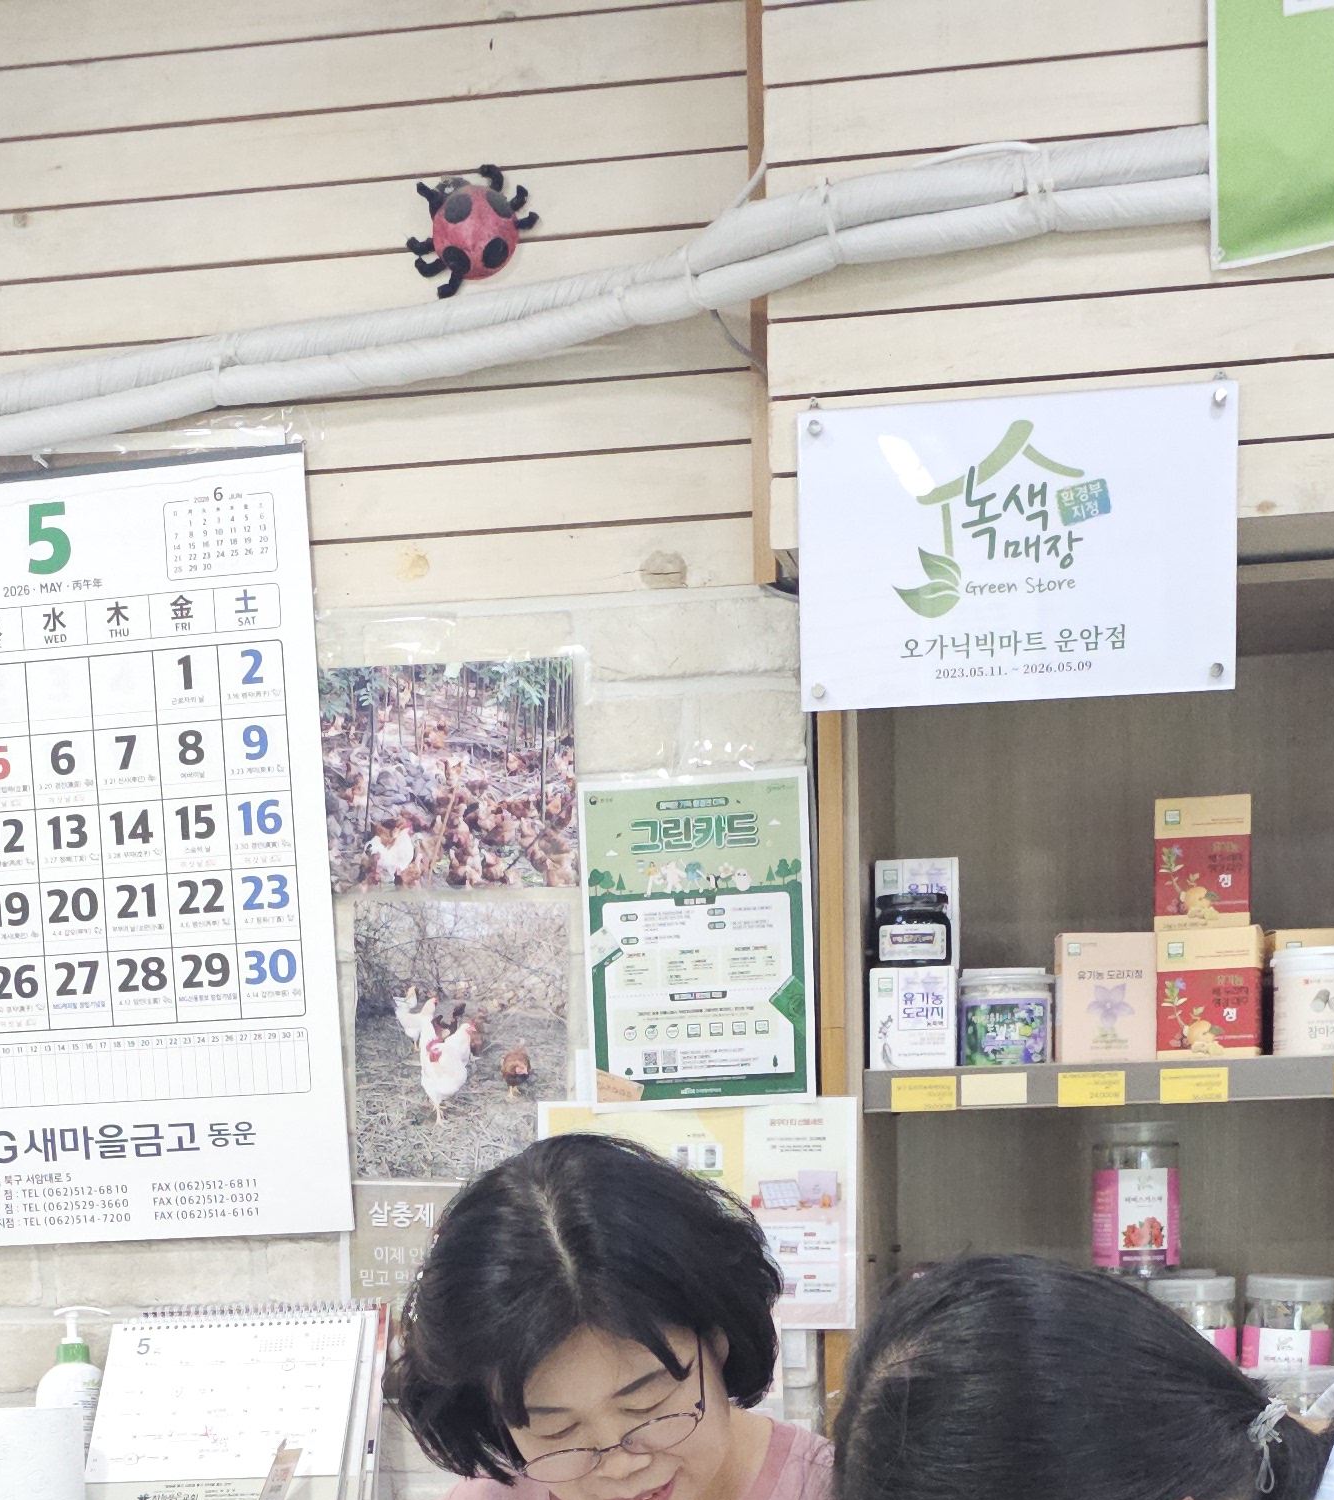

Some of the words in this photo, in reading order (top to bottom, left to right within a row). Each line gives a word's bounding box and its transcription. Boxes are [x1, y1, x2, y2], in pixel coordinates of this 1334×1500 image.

[1058, 480, 1106, 507] 환경부
[962, 466, 1048, 560] 녹색
[1070, 499, 1102, 521] 지정
[27, 500, 72, 576] 5
[1004, 530, 1084, 570] 매장
[2, 583, 30, 598] 2026
[39, 581, 63, 595] MAY
[72, 577, 104, 591] 丙午年
[965, 576, 1018, 597] Green
[1026, 573, 1077, 595] Store
[42, 606, 68, 633] 水
[105, 600, 130, 626] 木
[169, 594, 194, 621] 金
[233, 588, 259, 614] 土
[900, 630, 1048, 661] 오가닉빅마트
[1053, 624, 1127, 653] 운암점
[177, 654, 193, 691] 1
[240, 648, 264, 685] 2
[1022, 659, 1093, 676] 2026.05.09
[49, 740, 76, 776] 6
[114, 734, 137, 771] 7
[178, 729, 205, 766] 8
[242, 724, 269, 761] 9
[47, 813, 88, 850] 13
[108, 808, 154, 846] 14
[174, 803, 216, 841] 15
[237, 799, 283, 836] 16
[628, 811, 760, 856] 그린카드
[46, 886, 99, 924] 20
[115, 882, 157, 919] 21
[177, 878, 225, 915] 22
[240, 873, 290, 911] 23
[54, 960, 100, 997] 27
[116, 956, 168, 993] 28
[180, 952, 231, 990] 29
[244, 948, 298, 986] 30
[902, 991, 945, 1006] 유기농
[23, 1122, 201, 1164] 새마을금고
[207, 1120, 257, 1148] 동운
[4, 1175, 23, 1186] 북구
[25, 1173, 64, 1185] 서암대로
[42, 1184, 129, 1198] (062)512-6810
[173, 1178, 258, 1192] (062)512-6811
[43, 1199, 129, 1212] (062)529-3660
[175, 1192, 260, 1207] (062)512-0302
[44, 1212, 131, 1227] (062)514-7200
[175, 1206, 260, 1221] (062)514-6161
[368, 1200, 435, 1228] 살충제
[359, 1269, 391, 1288] 믿고
[136, 1337, 152, 1356] 5
